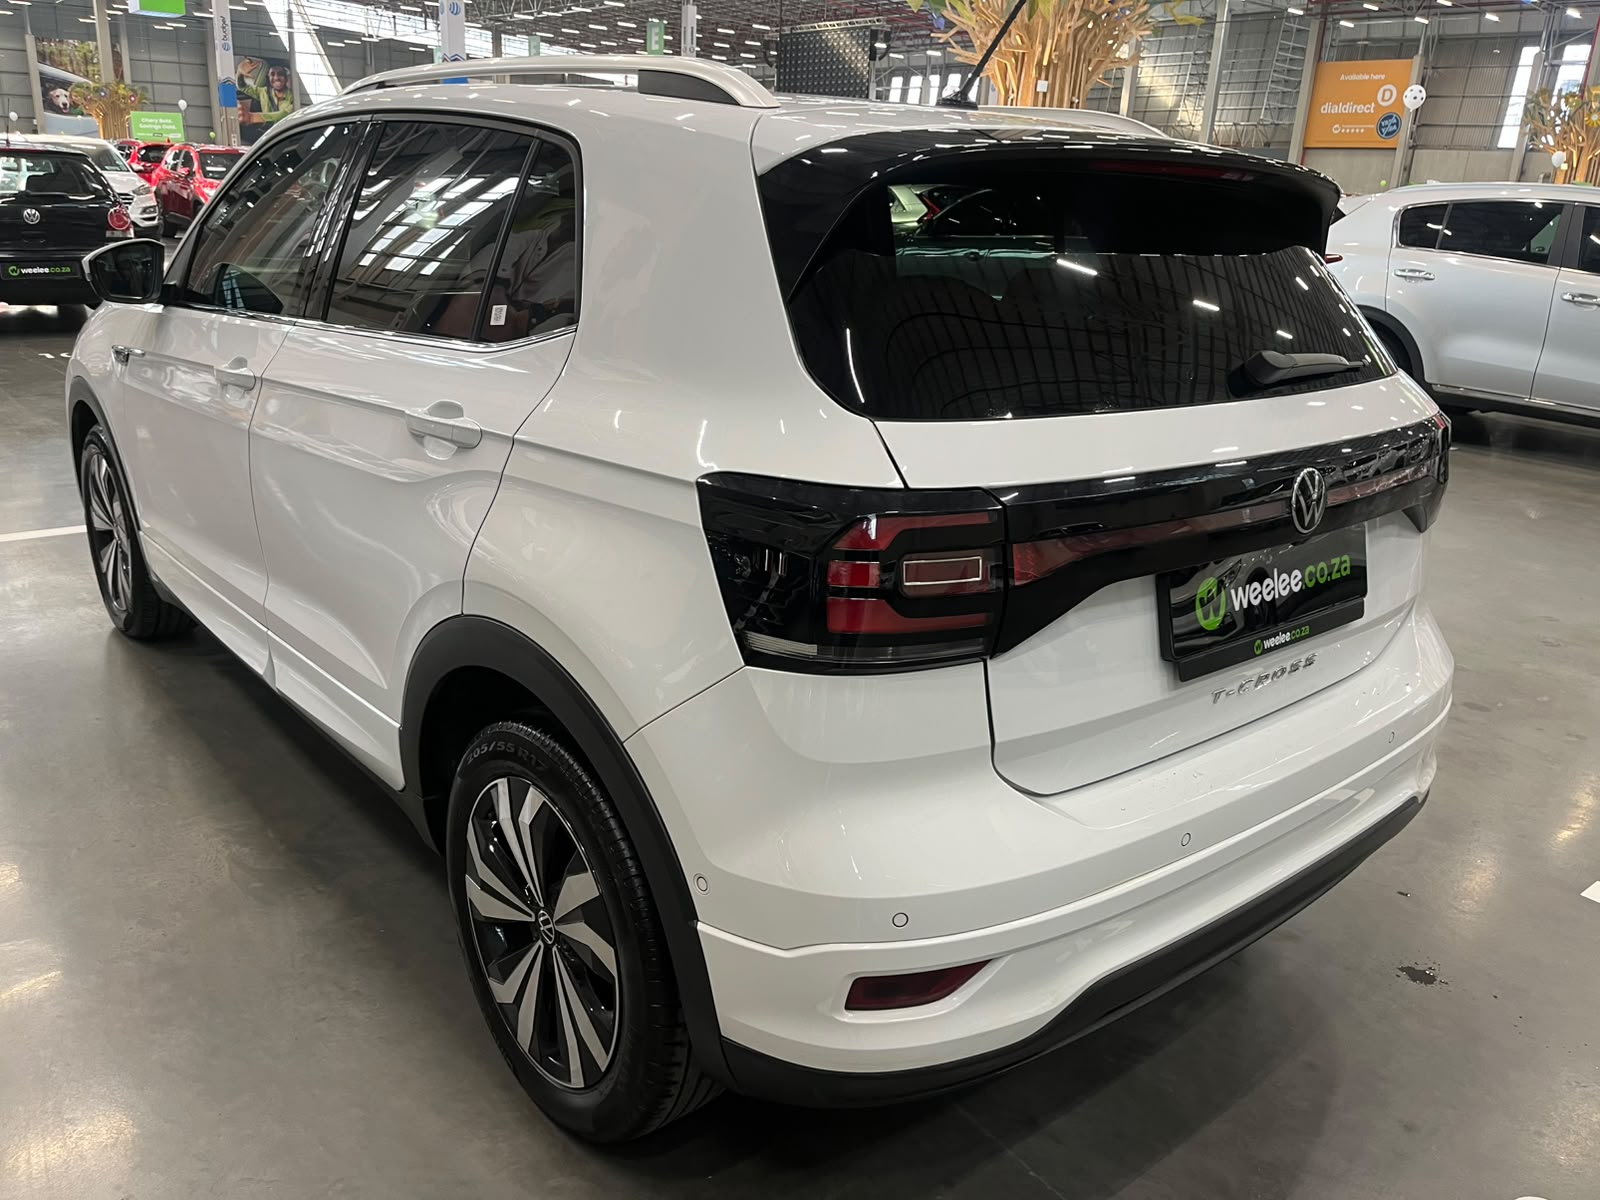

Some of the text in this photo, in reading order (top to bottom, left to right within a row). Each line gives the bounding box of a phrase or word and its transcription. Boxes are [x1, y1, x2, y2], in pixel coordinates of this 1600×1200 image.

[1320, 102, 1375, 113] dialdirect
[21, 266, 71, 274] weelee.co.za
[1230, 554, 1351, 611] weelee.co.za
[1263, 625, 1310, 649] weelee.co.za
[1211, 653, 1319, 704] T-CROSS
